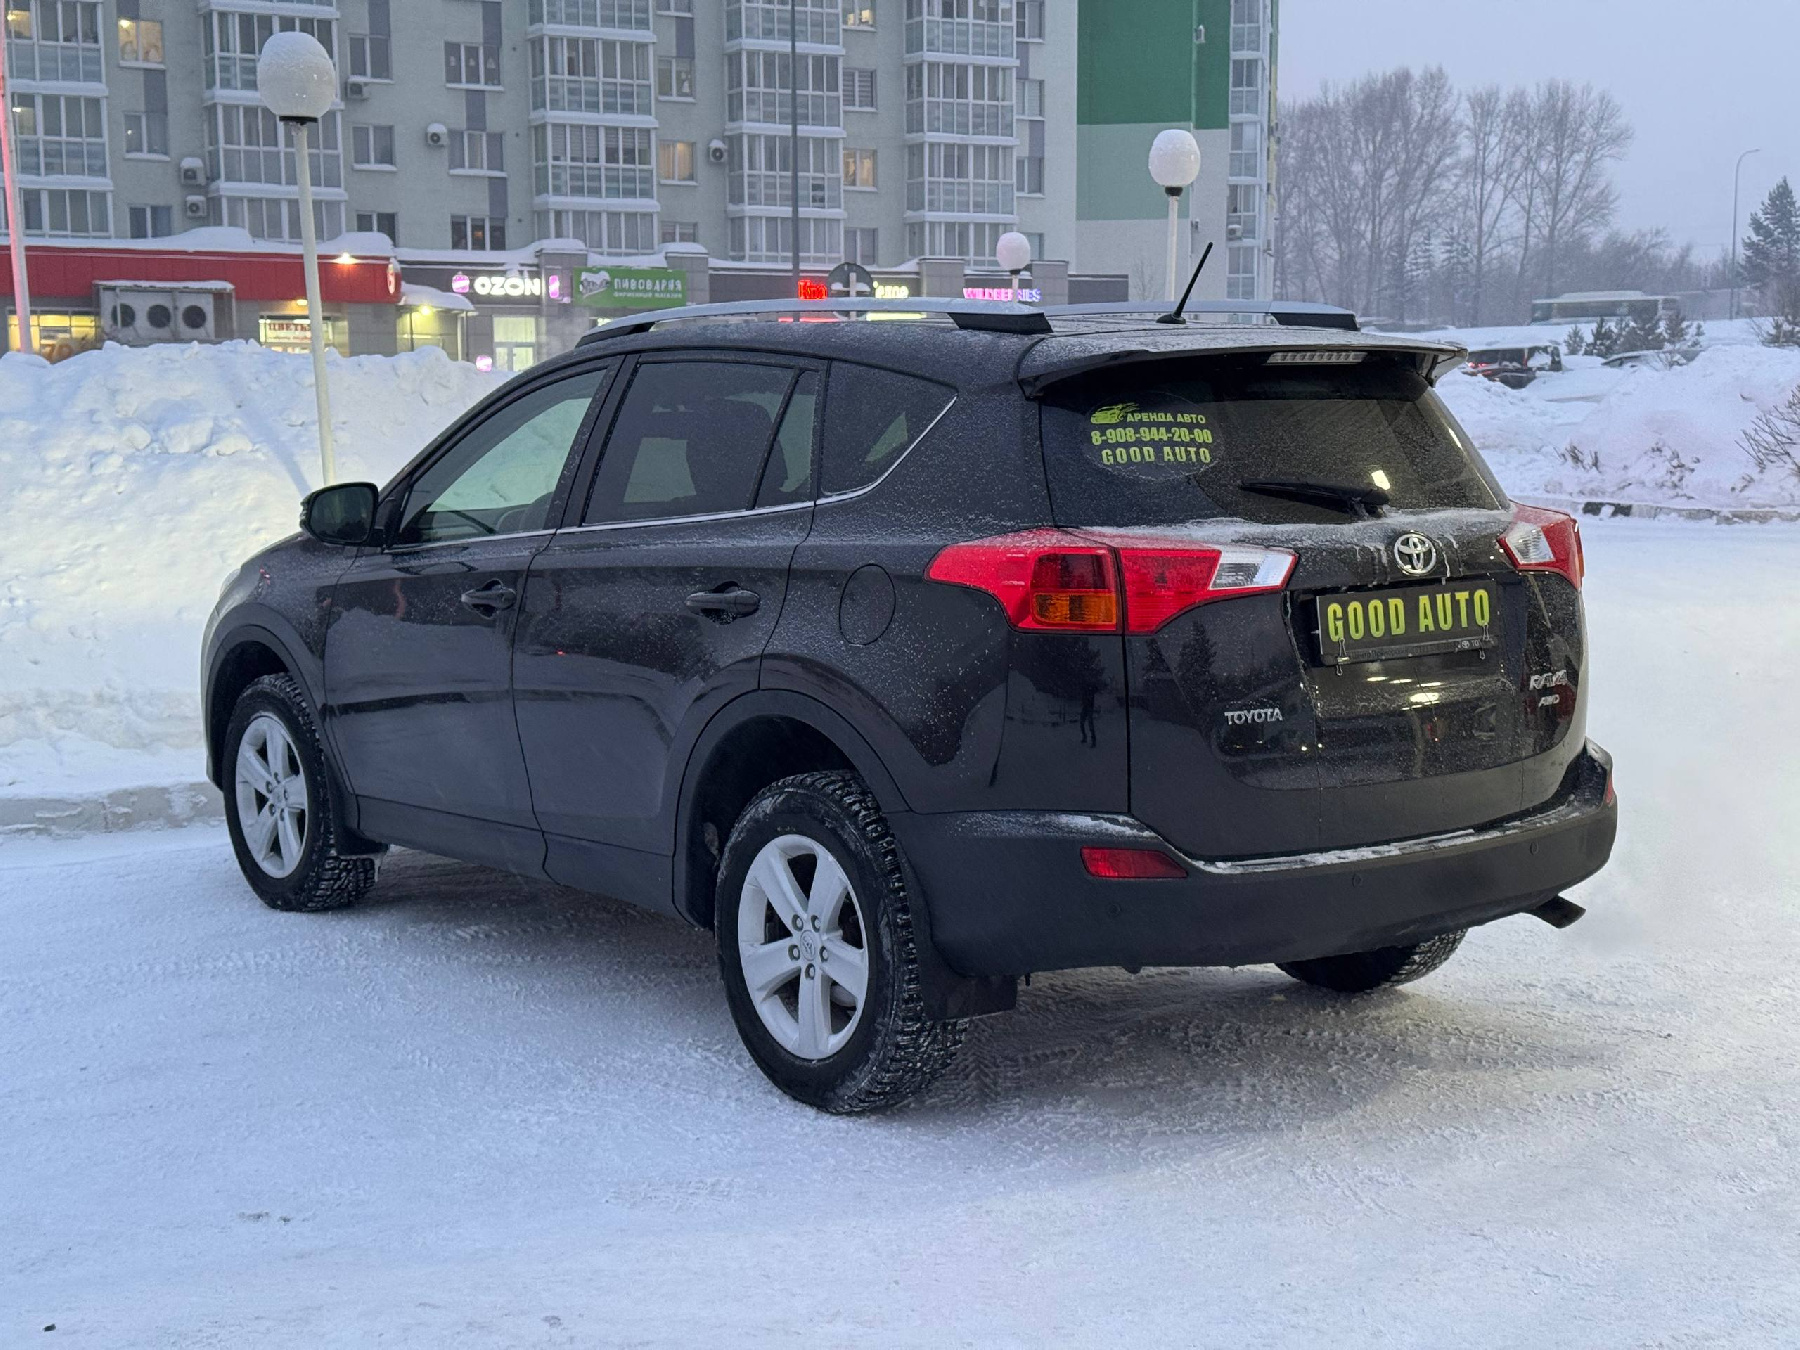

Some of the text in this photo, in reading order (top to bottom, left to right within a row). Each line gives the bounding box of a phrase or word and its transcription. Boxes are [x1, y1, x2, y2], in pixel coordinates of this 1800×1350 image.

[473, 276, 541, 297] OZON
[614, 277, 683, 292] ПИВОВАРИЯ
[1126, 412, 1206, 424] АРЕНДА АВТО
[1090, 427, 1213, 446] 8-908-944-20-00
[1101, 446, 1211, 465] GOOD AUTO
[1327, 588, 1490, 642] GOOD AUTO
[1223, 707, 1284, 725] TOYOTA
